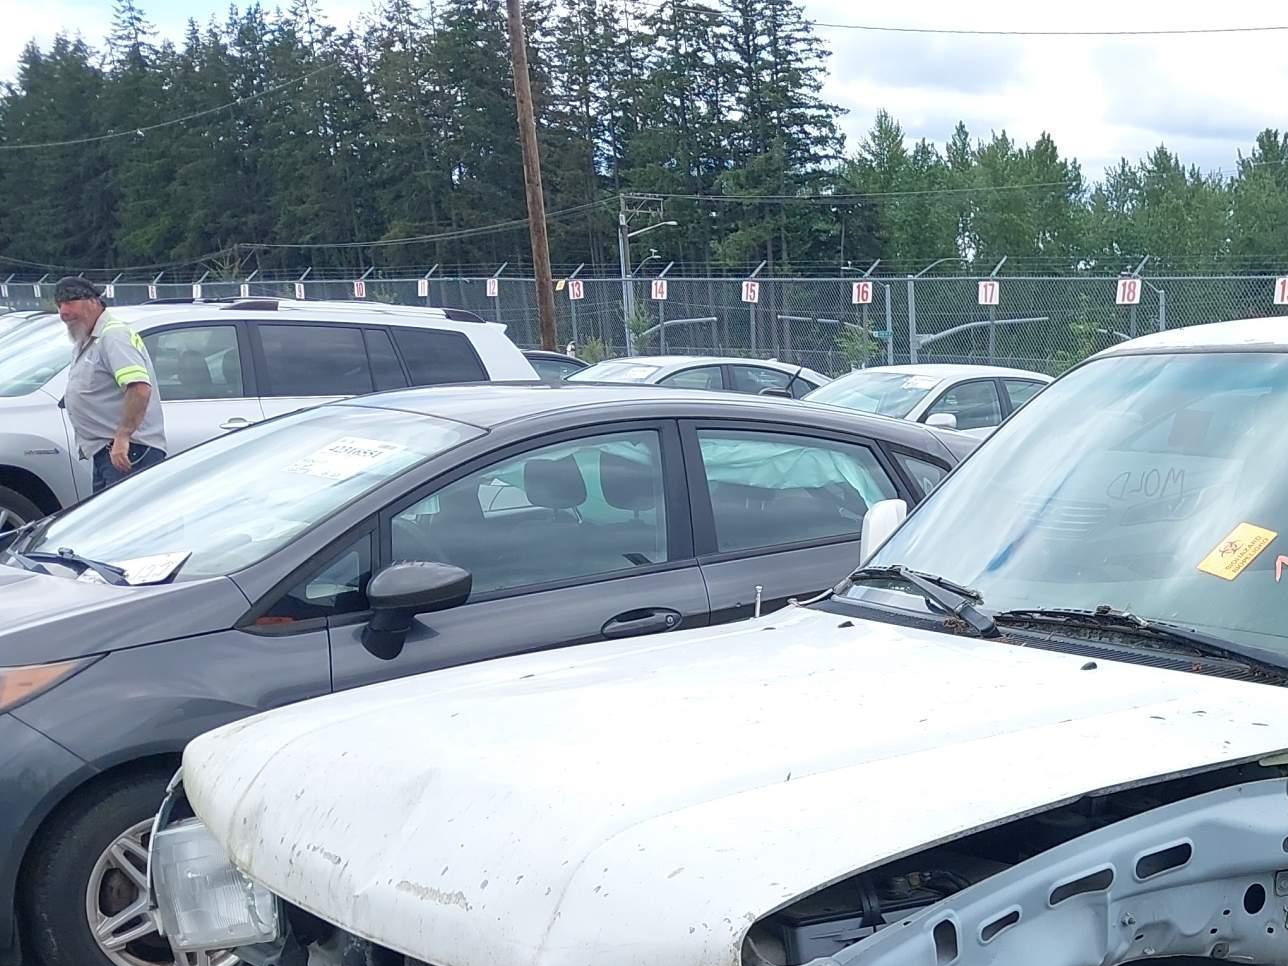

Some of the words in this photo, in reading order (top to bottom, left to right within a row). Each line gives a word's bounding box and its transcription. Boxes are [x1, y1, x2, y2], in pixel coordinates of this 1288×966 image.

[356, 282, 364, 297] 10
[488, 281, 496, 296] 12
[571, 281, 581, 298] 13
[654, 281, 665, 299] 14
[745, 283, 756, 301] 15
[856, 283, 869, 302] 16
[983, 283, 995, 302] 17
[1120, 280, 1137, 303] 18
